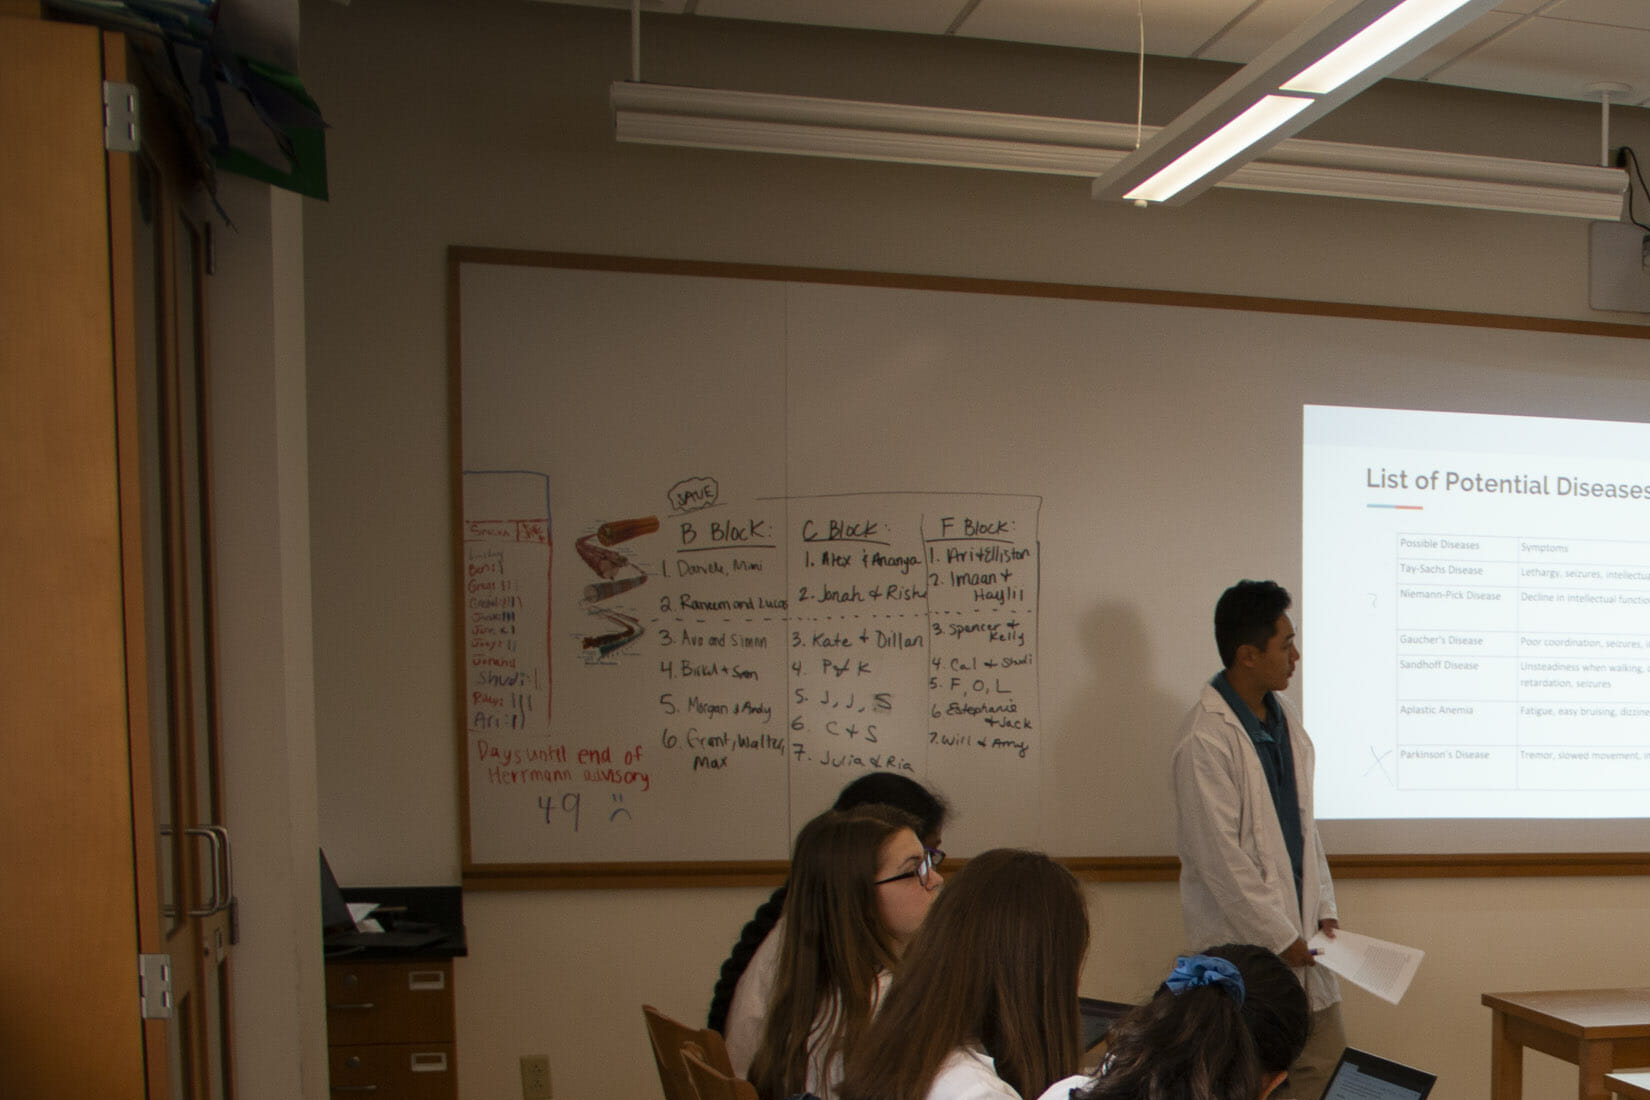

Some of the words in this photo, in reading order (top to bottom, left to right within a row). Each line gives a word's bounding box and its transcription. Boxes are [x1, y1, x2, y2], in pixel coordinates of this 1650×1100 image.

[1366, 468, 1408, 489] List
[1415, 471, 1440, 491] of
[1446, 471, 1551, 496] Potential
[680, 522, 697, 544] B
[803, 520, 818, 540] C
[941, 516, 955, 537] F
[1400, 538, 1438, 550] Possible
[1440, 540, 1480, 551] Diseases
[1521, 543, 1569, 555] Symptoms
[1400, 564, 1446, 576] Tay-Sachs
[1449, 566, 1484, 576] Disease
[1521, 568, 1562, 580] Lethargy,
[1565, 570, 1603, 581] seizures,
[1400, 589, 1464, 601] Niemann-Pick
[1466, 591, 1501, 602] Disease
[1521, 592, 1554, 603] Decline
[1557, 593, 1565, 603] in
[1568, 594, 1616, 605] intellectual
[812, 632, 852, 648] Kate
[990, 631, 1024, 647] Kelly
[1400, 635, 1446, 646] Gaucher's
[1448, 635, 1483, 646] Disease
[1520, 637, 1542, 647] Poor
[1606, 640, 1643, 650] seizures,
[857, 660, 872, 676] K
[950, 657, 977, 672] Cal
[1400, 660, 1441, 671] Sandhoff
[1444, 661, 1479, 671] Disease
[1520, 662, 1580, 673] Unsteadiness
[1582, 664, 1606, 673] when
[1609, 663, 1645, 674] walking,
[995, 678, 1012, 693] L
[1520, 678, 1574, 689] retardation,
[1576, 679, 1611, 689] seizures
[873, 692, 892, 710] S
[1400, 705, 1436, 717] Aplastic
[1439, 705, 1474, 715] Anemia
[1520, 706, 1555, 718] Fatigue,
[1558, 708, 1578, 718] easy
[1580, 706, 1618, 718] bruising,
[826, 721, 840, 736] C
[865, 724, 878, 743] S
[477, 740, 522, 767] Days
[577, 744, 611, 765] end
[624, 745, 643, 765] of
[820, 750, 865, 768] Julia
[1400, 750, 1453, 760] Parkinson's
[1456, 750, 1490, 760] Disease
[1520, 750, 1556, 761] Tremor,
[1558, 750, 1589, 760] slowed
[693, 756, 728, 771] Max
[488, 766, 573, 785] Herrmann
[583, 768, 650, 792] advisory
[538, 792, 581, 832] 49
